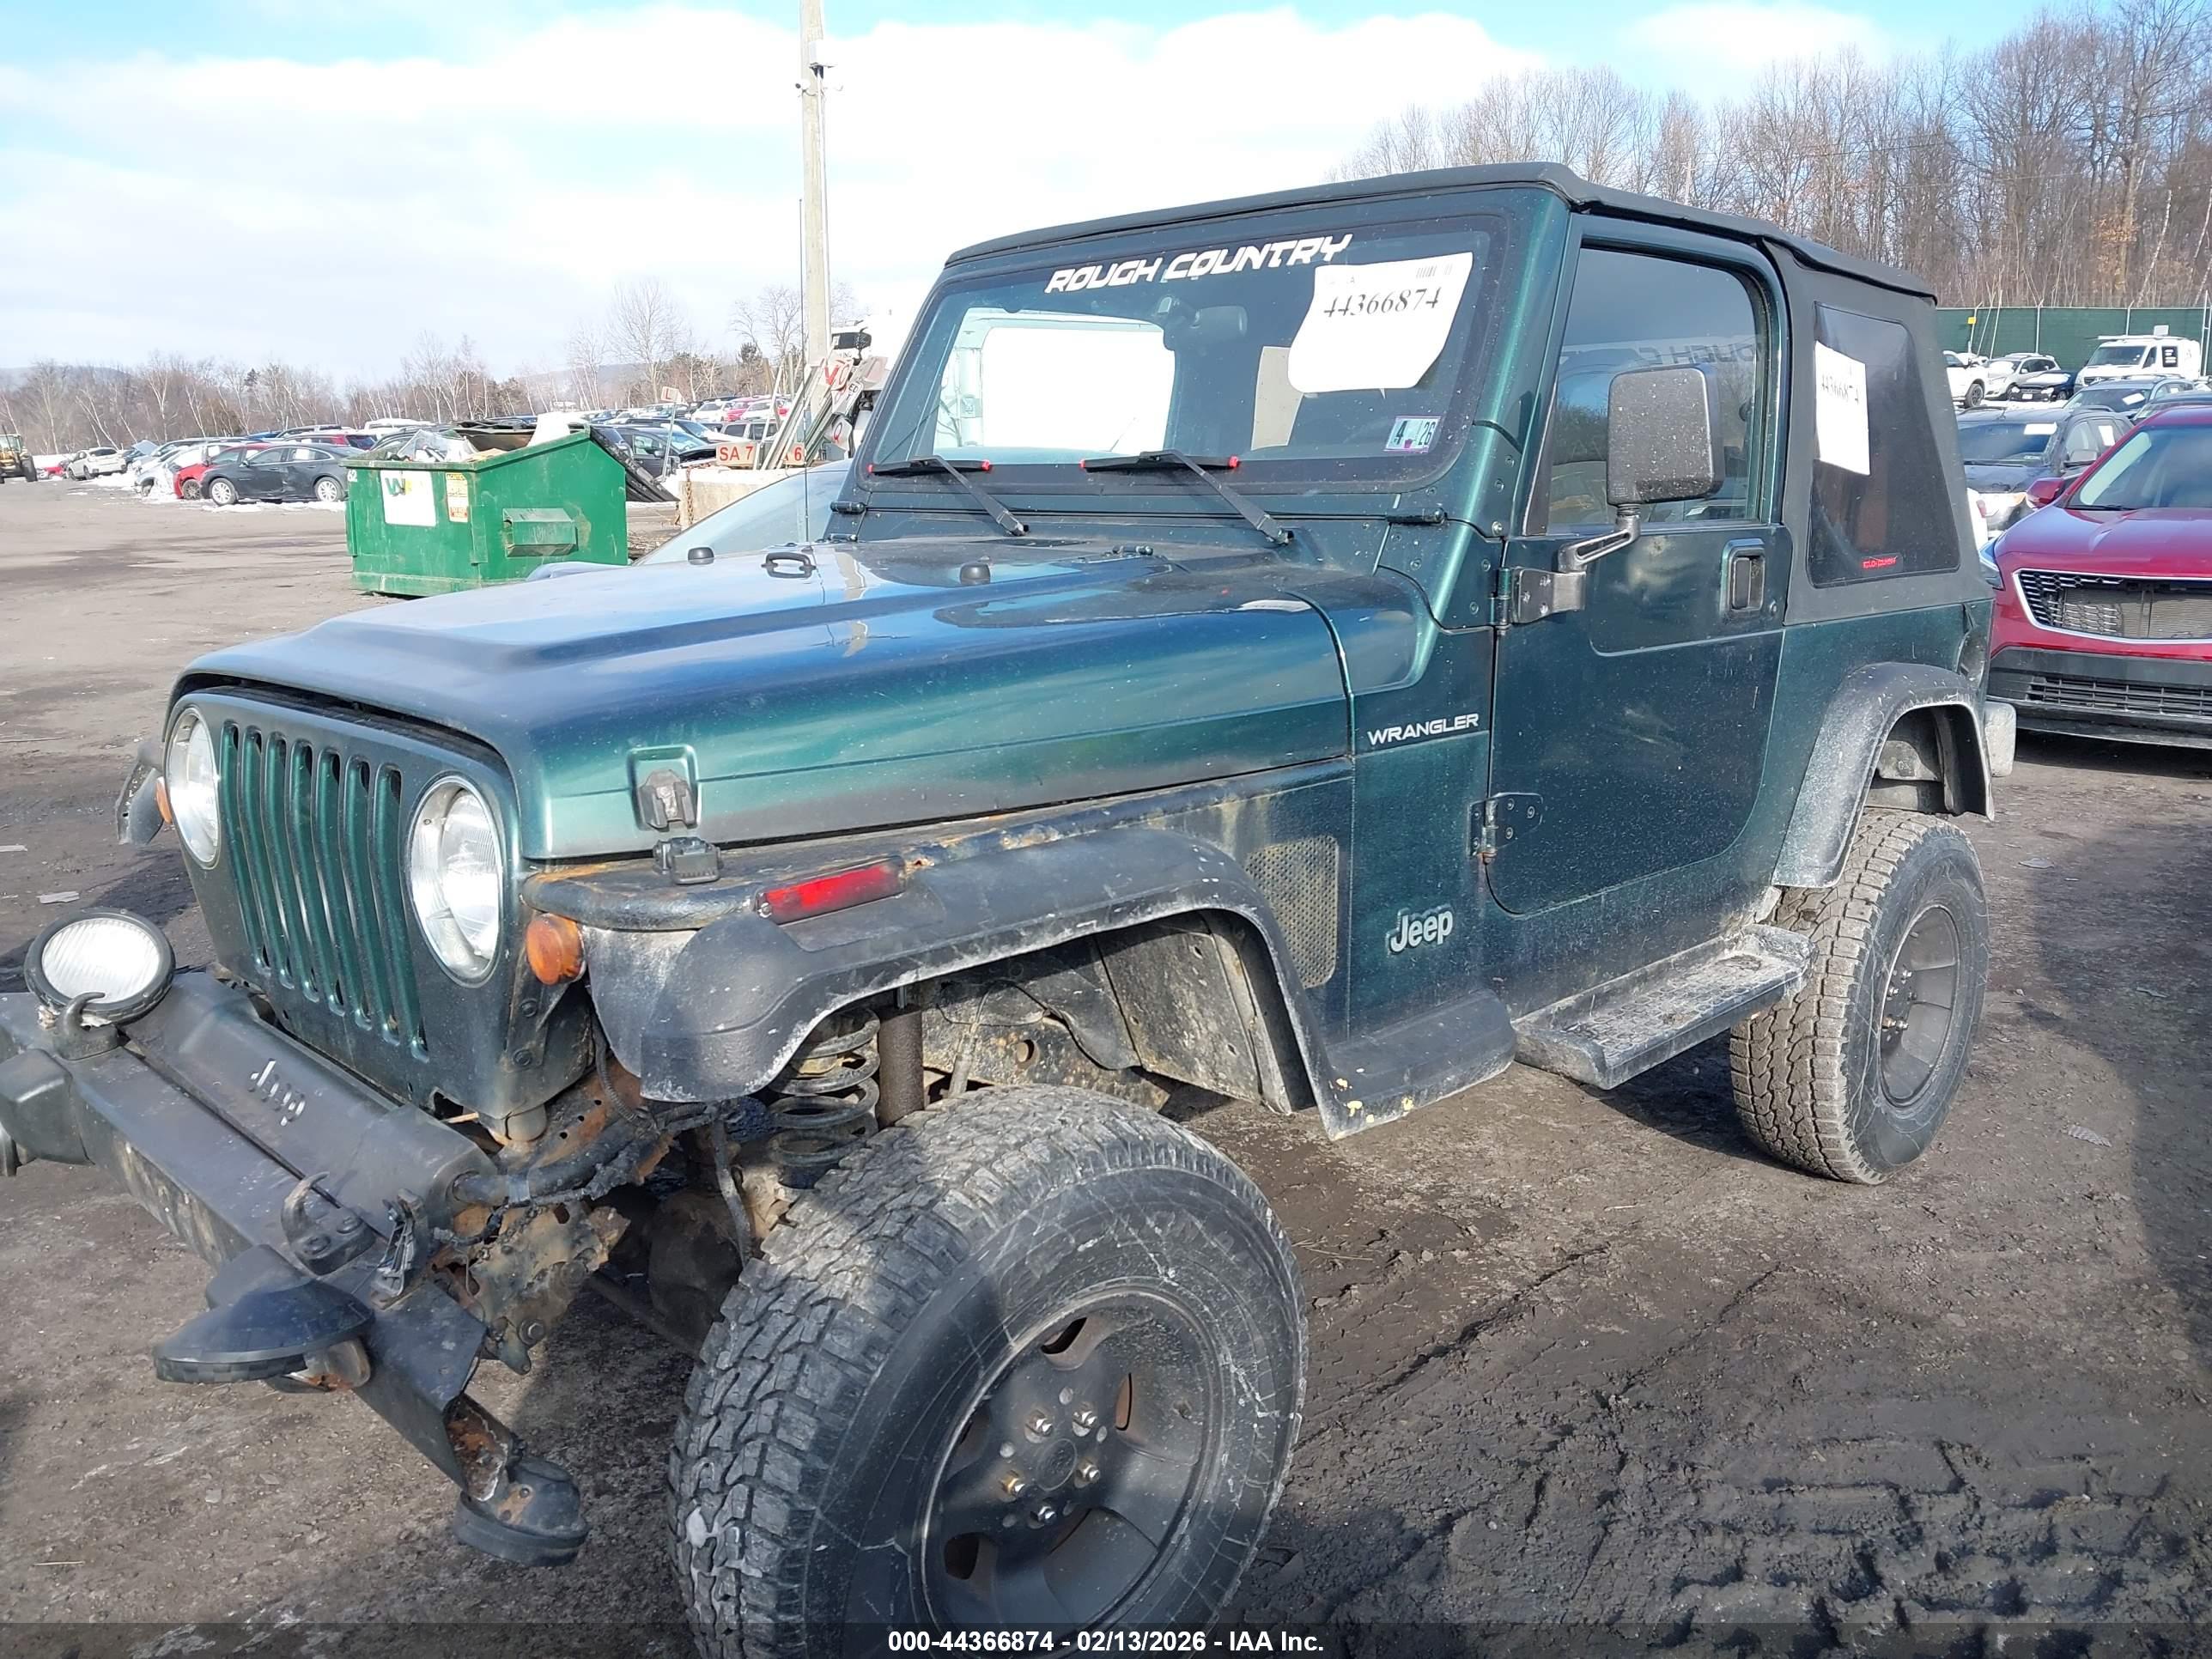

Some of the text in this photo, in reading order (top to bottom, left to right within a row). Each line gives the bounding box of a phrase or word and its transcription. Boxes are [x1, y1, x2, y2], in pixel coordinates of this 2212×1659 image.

[1044, 234, 1353, 294] ROUGH COUNTRY
[1323, 286, 1443, 318] 44366874
[720, 446, 754, 461] SA 7
[1367, 713, 1480, 746] WRANGLER
[1390, 910, 1454, 952] Jeep
